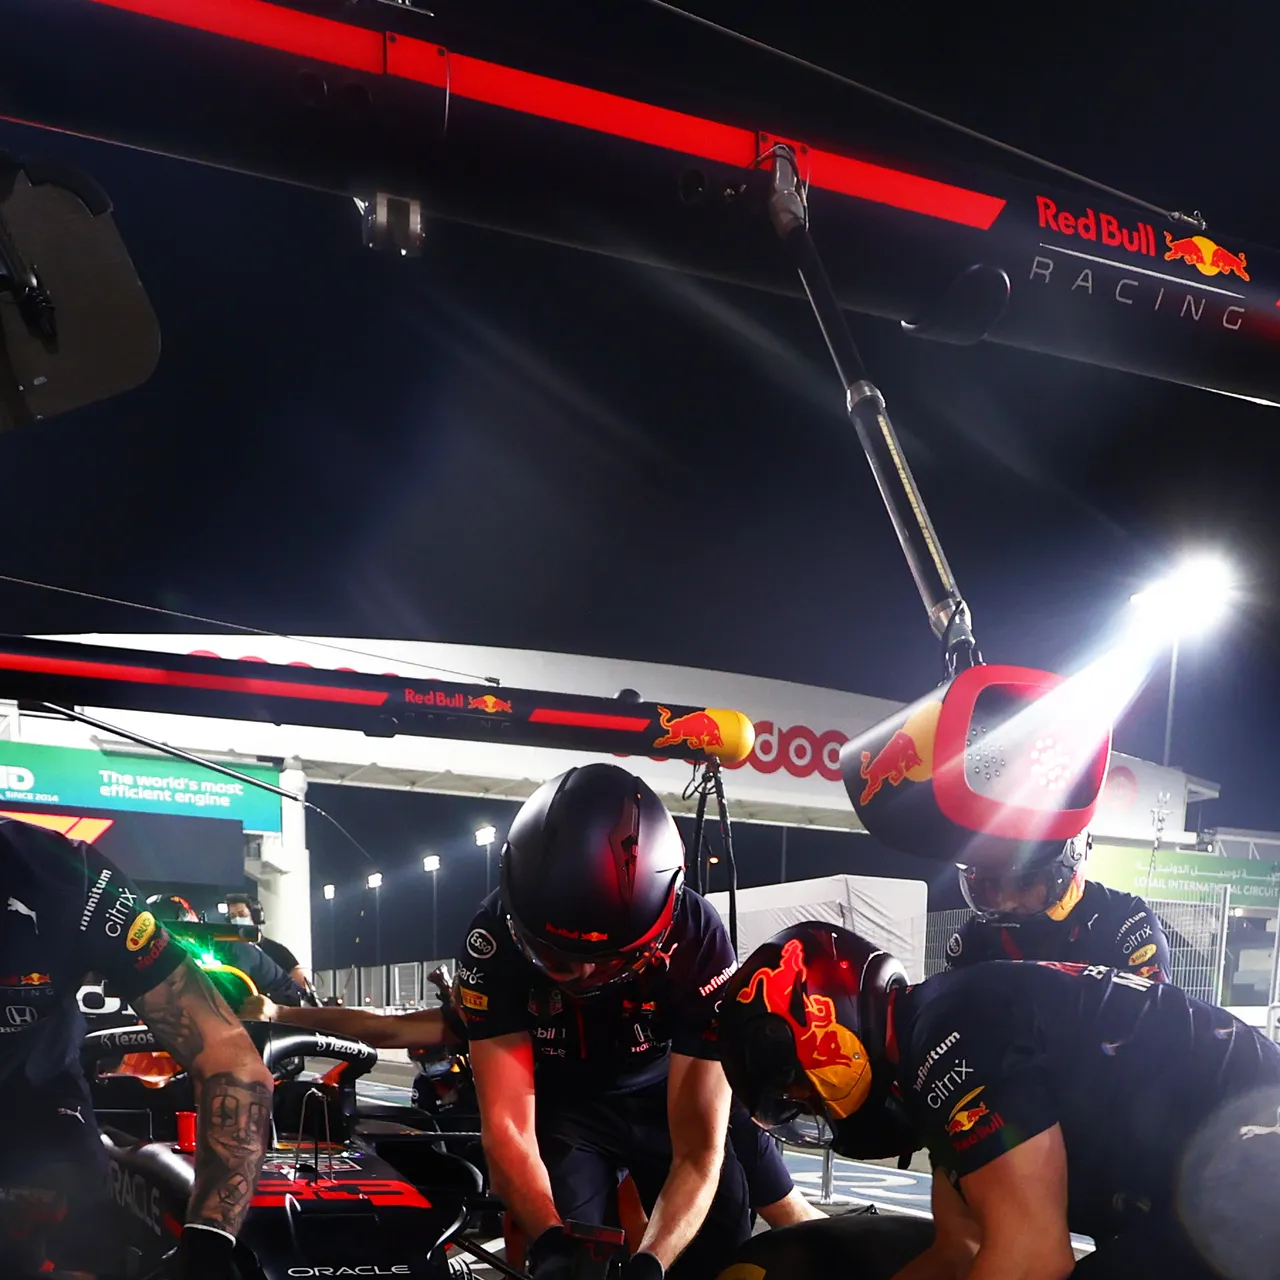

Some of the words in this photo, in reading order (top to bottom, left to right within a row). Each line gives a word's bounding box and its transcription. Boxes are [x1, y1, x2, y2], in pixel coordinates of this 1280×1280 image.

[1036, 195, 1097, 240] Red
[1100, 212, 1156, 257] Bull
[1029, 256, 1245, 330] RACING
[405, 688, 433, 705] Red
[436, 692, 464, 708] Bull
[99, 769, 132, 785] The
[136, 773, 198, 790] world's
[201, 780, 243, 795] most
[5, 791, 33, 801] SINCE
[100, 784, 172, 801] efficient
[175, 791, 231, 807] engine
[1243, 885, 1279, 898] CIRCUIT
[105, 887, 137, 938] citrix
[1122, 923, 1153, 954] citrix
[115, 1032, 155, 1046] Tezos
[533, 1028, 556, 1039] bil
[328, 1036, 358, 1055] Tezos
[927, 1059, 974, 1109] citrix
[287, 1265, 411, 1277] ORACLE
